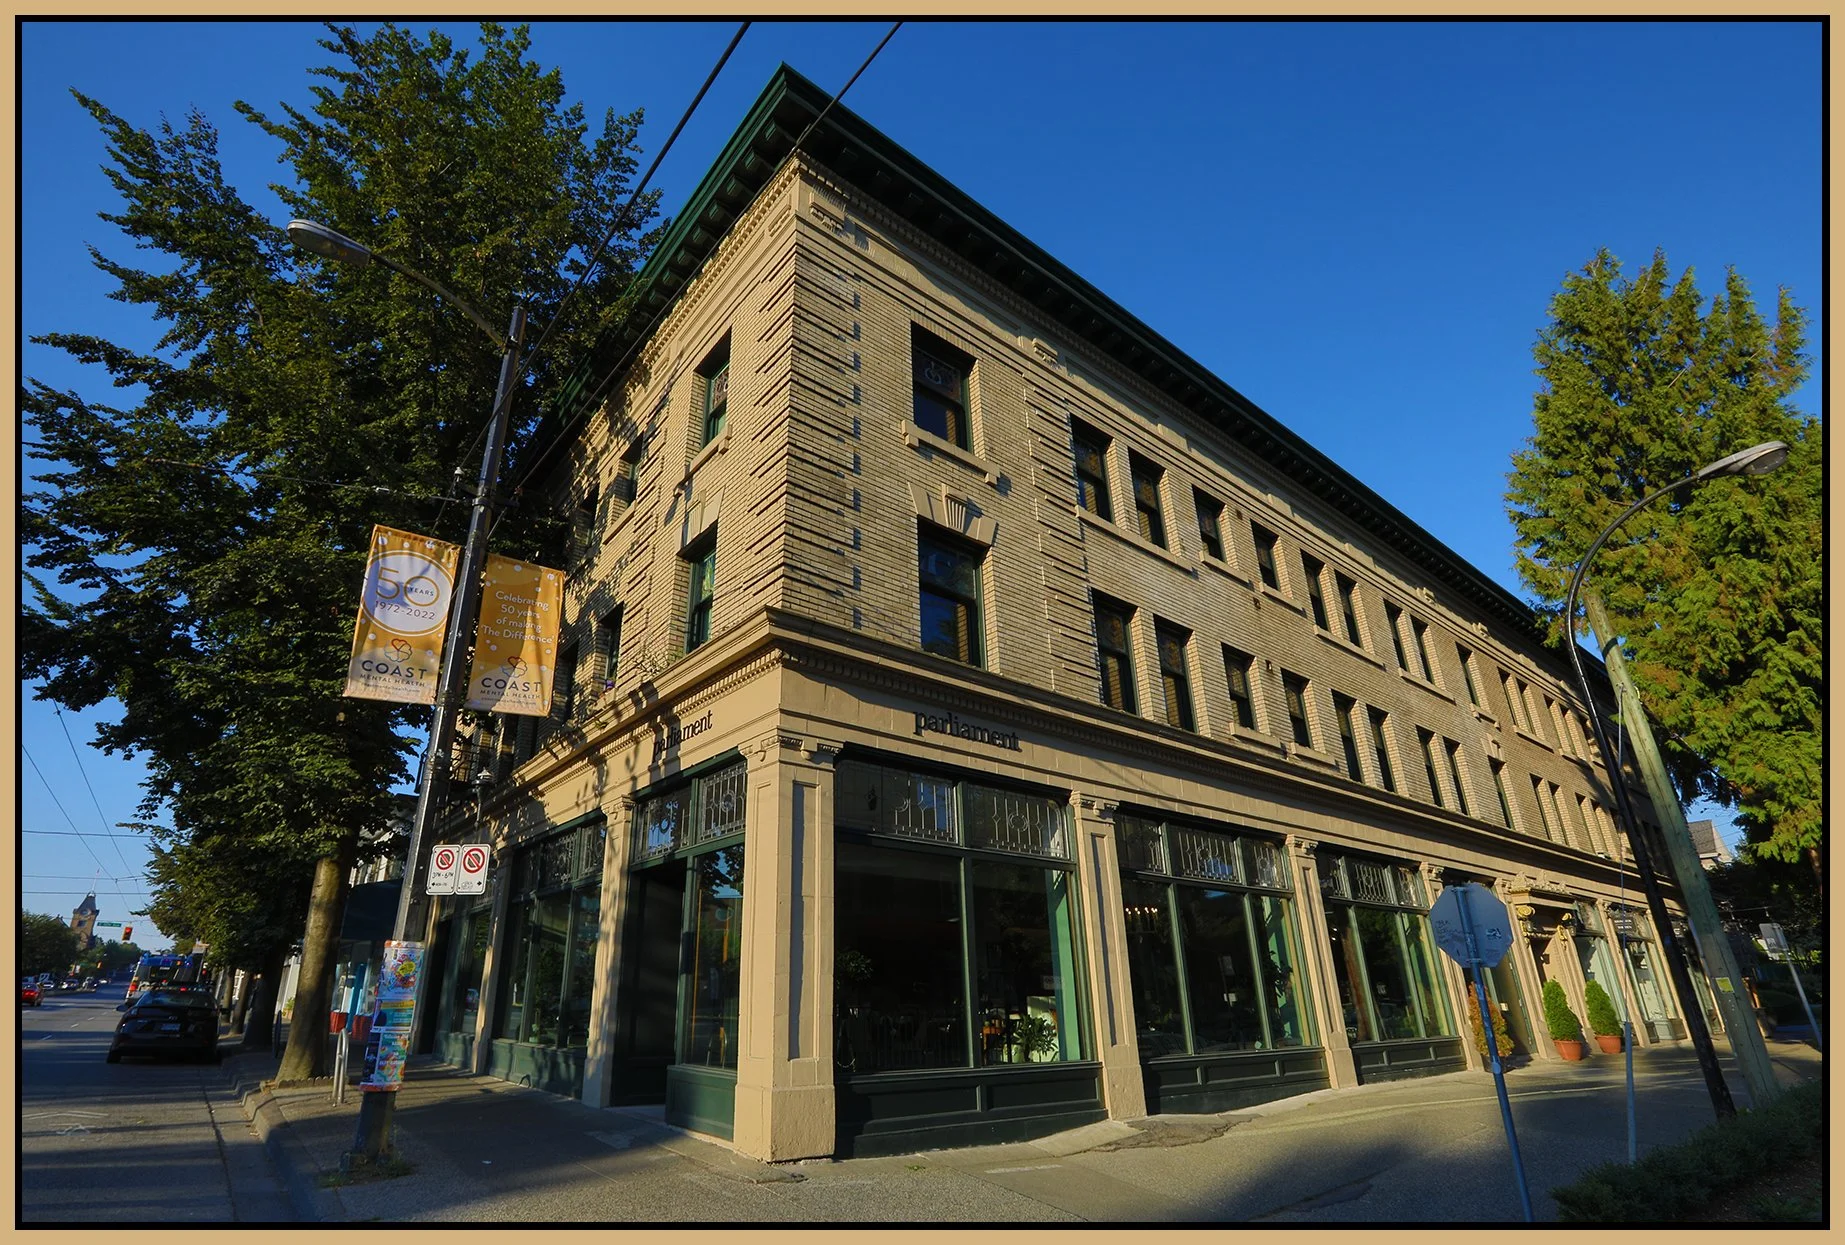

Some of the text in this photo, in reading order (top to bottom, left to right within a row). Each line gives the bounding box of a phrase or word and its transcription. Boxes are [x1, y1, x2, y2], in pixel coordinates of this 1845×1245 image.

[409, 587, 434, 596] YEARS
[375, 600, 436, 620] 1972-2022
[495, 590, 549, 612] Celebrating
[501, 604, 540, 619] 50 years
[496, 616, 542, 634] of making
[361, 660, 427, 680] COAST
[360, 673, 425, 687] MENTAL HEALTH
[481, 677, 541, 692] COAST
[480, 689, 509, 697] MENTAL
[652, 709, 713, 764] parliament
[913, 711, 1023, 753] parliament
